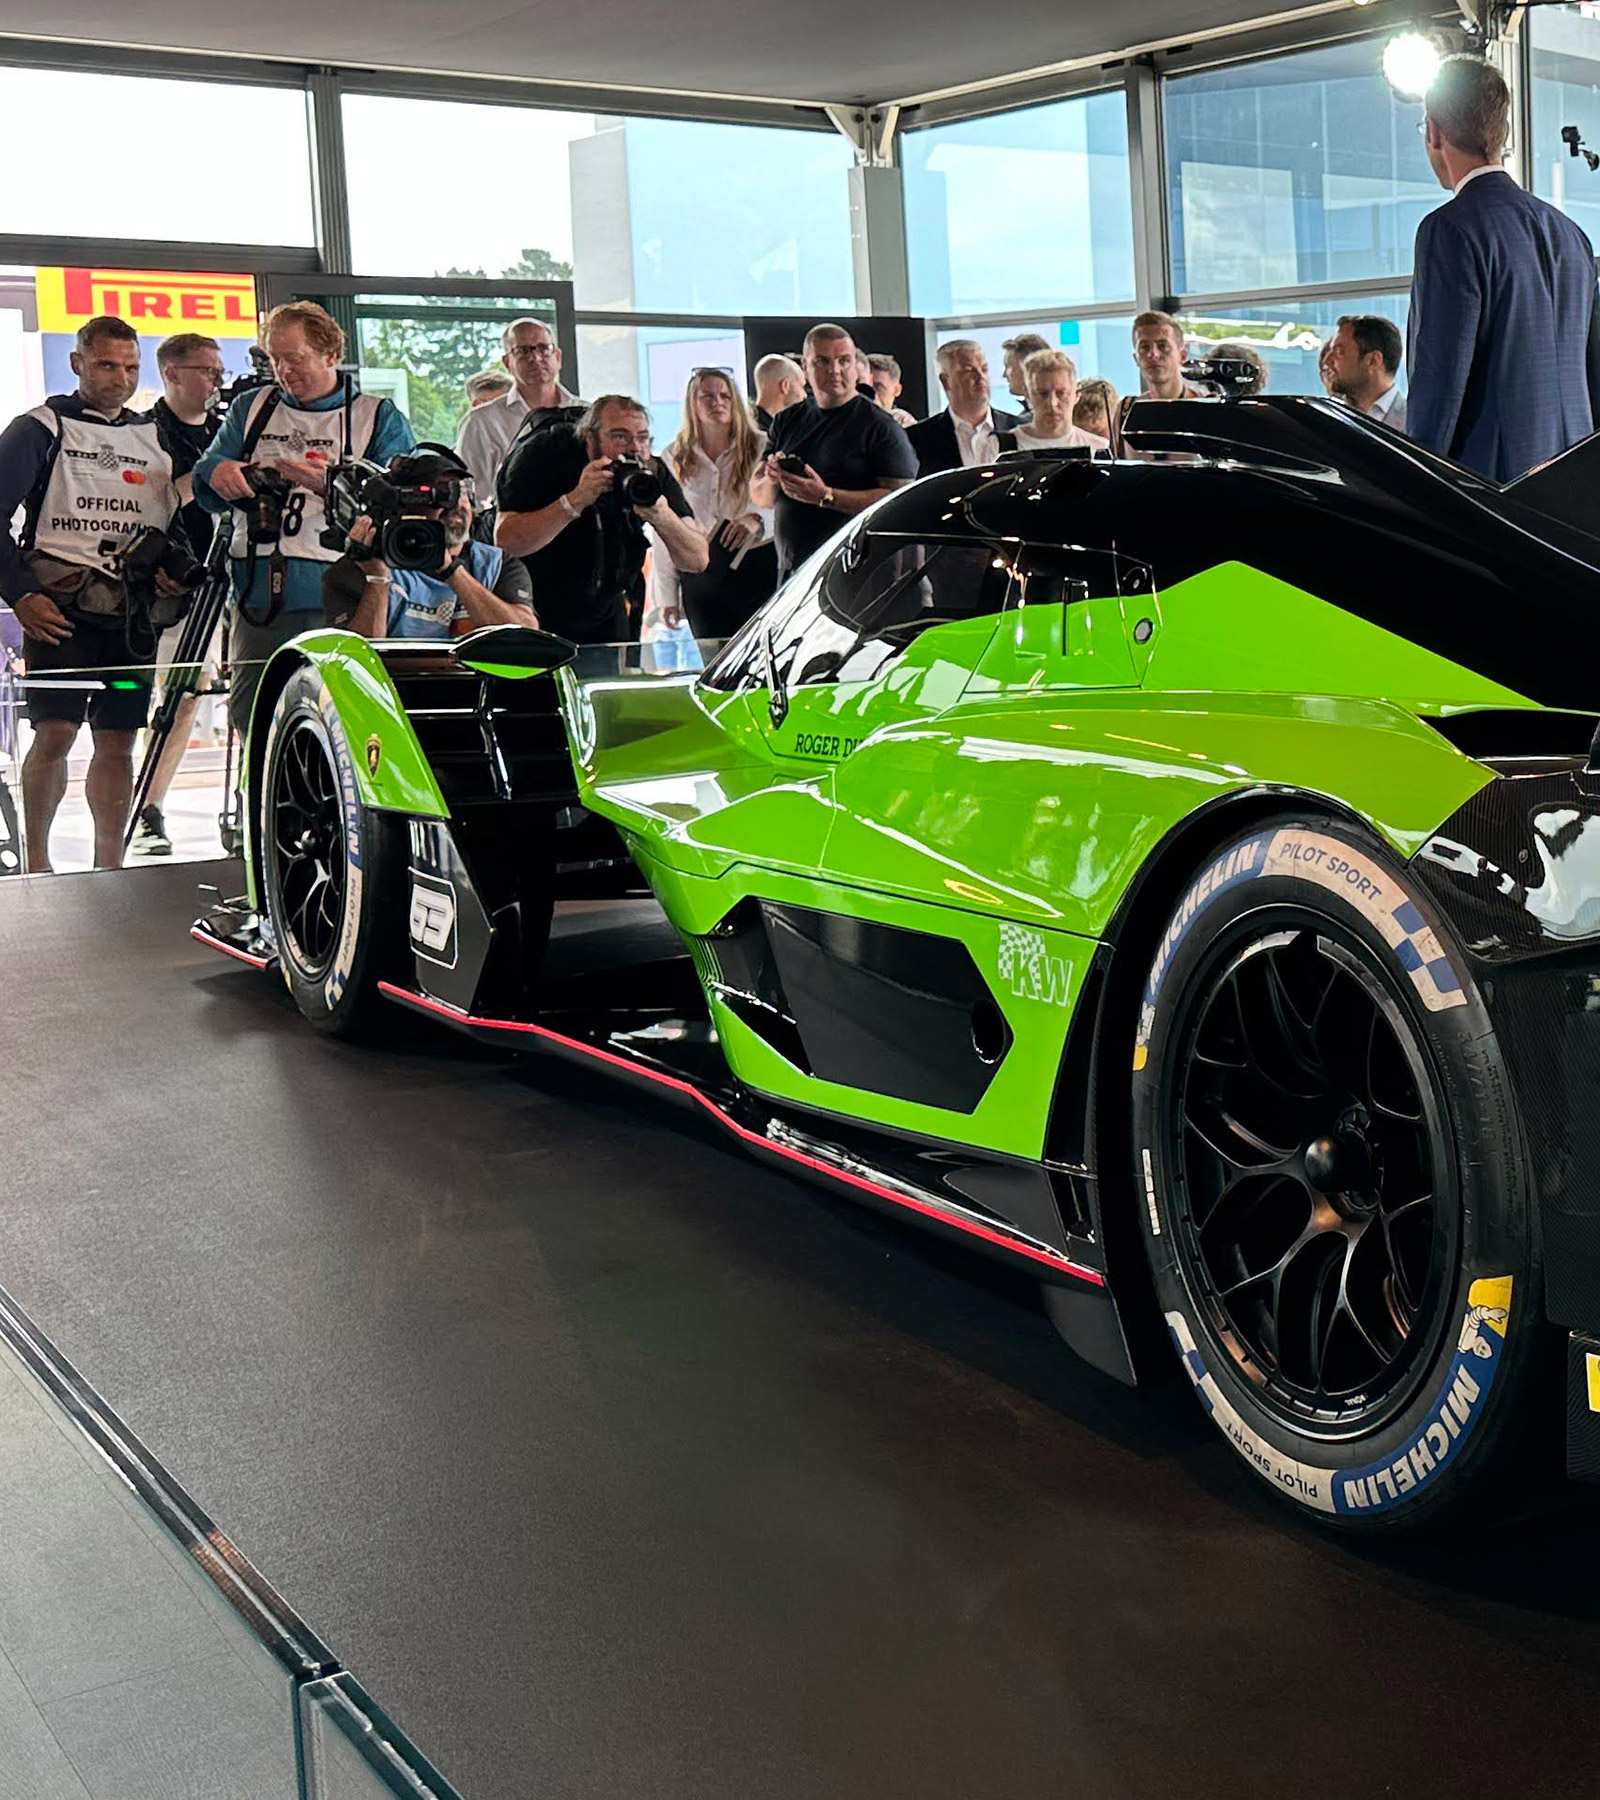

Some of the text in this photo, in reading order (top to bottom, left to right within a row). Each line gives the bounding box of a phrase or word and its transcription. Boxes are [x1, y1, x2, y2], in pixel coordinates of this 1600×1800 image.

[76, 496, 142, 513] OFFICIAL
[794, 733, 840, 756] ROGER
[331, 721, 361, 857] MICHELIN
[1279, 842, 1382, 901] PILOT SPORT
[1149, 841, 1261, 996] MICHELIN
[1011, 950, 1074, 1007] KW
[1223, 1422, 1318, 1499] PILOT SPORT
[1343, 1364, 1481, 1509] MICHELIN
